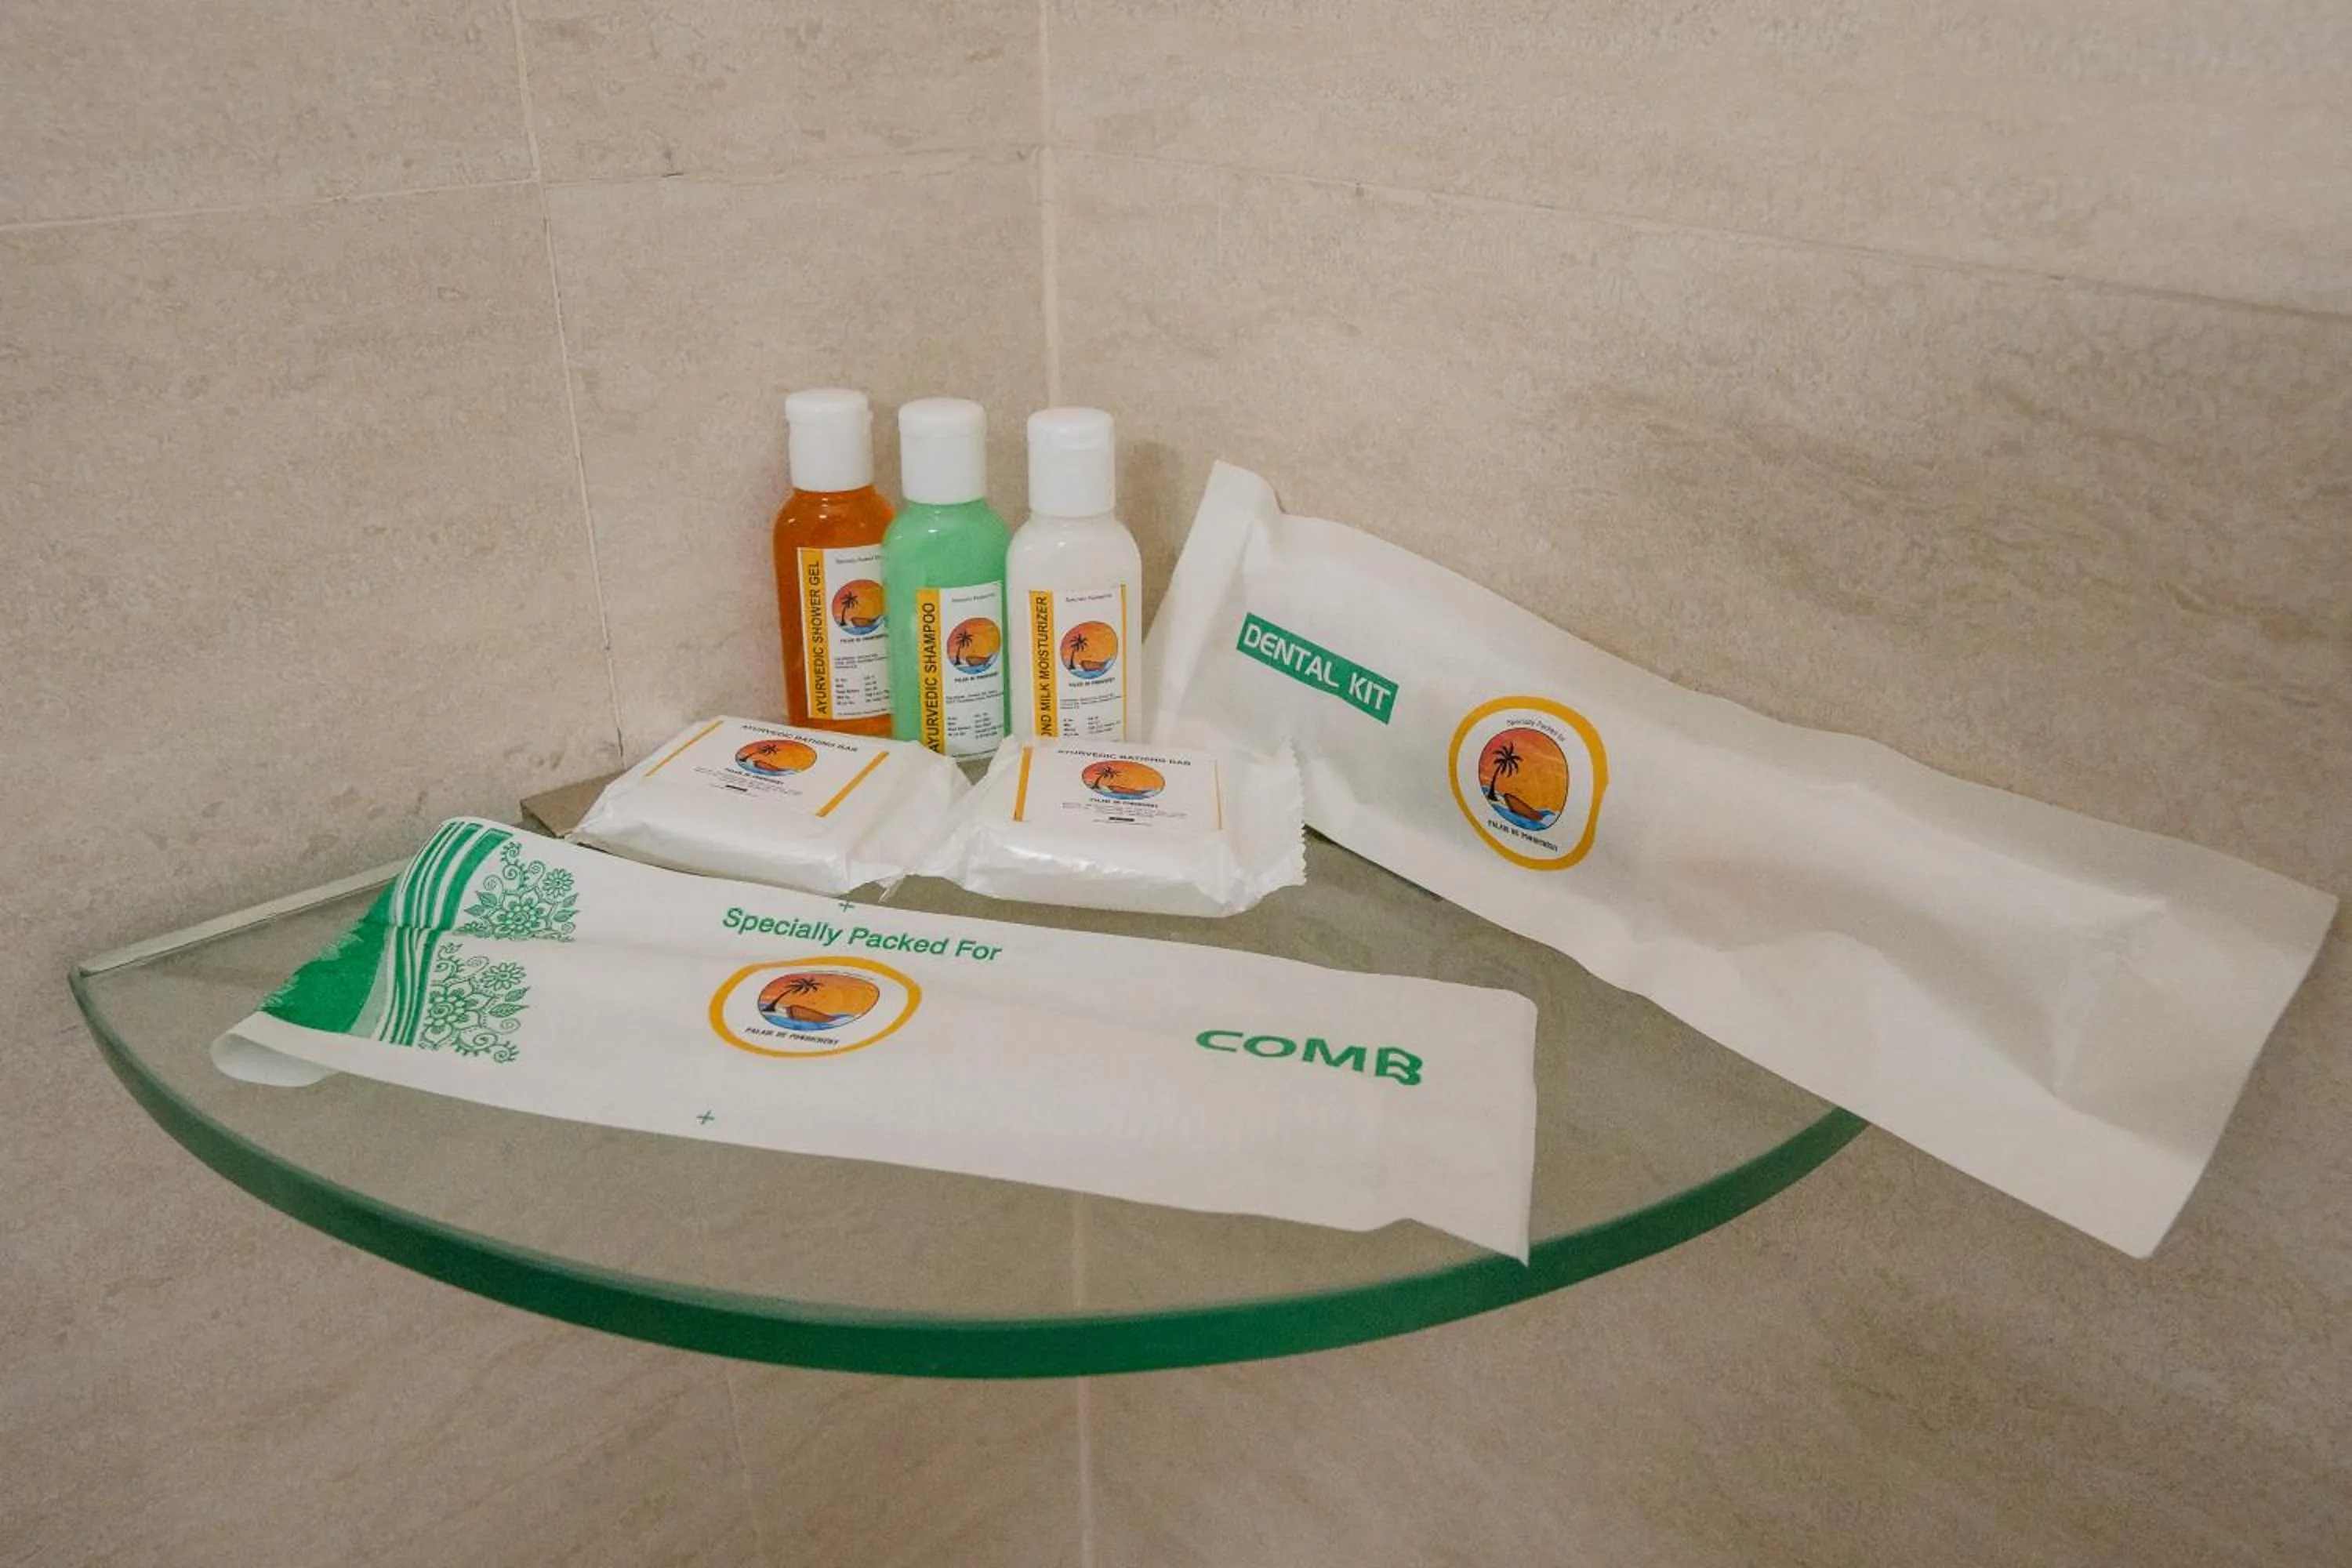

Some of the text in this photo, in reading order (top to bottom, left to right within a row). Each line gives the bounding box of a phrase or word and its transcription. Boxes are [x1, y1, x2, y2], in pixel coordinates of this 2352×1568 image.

[808, 561, 827, 713] AYURVEDIC SHOWER GEL
[922, 602, 940, 753] AYURVEDIC SHAMPOO
[1036, 597, 1051, 681] MOISTURIZER
[1243, 622, 1392, 710] DENTAL KIT
[1039, 684, 1051, 711] MILK
[722, 907, 1003, 961] Specially Packed For
[1195, 1029, 1424, 1086] COMB
